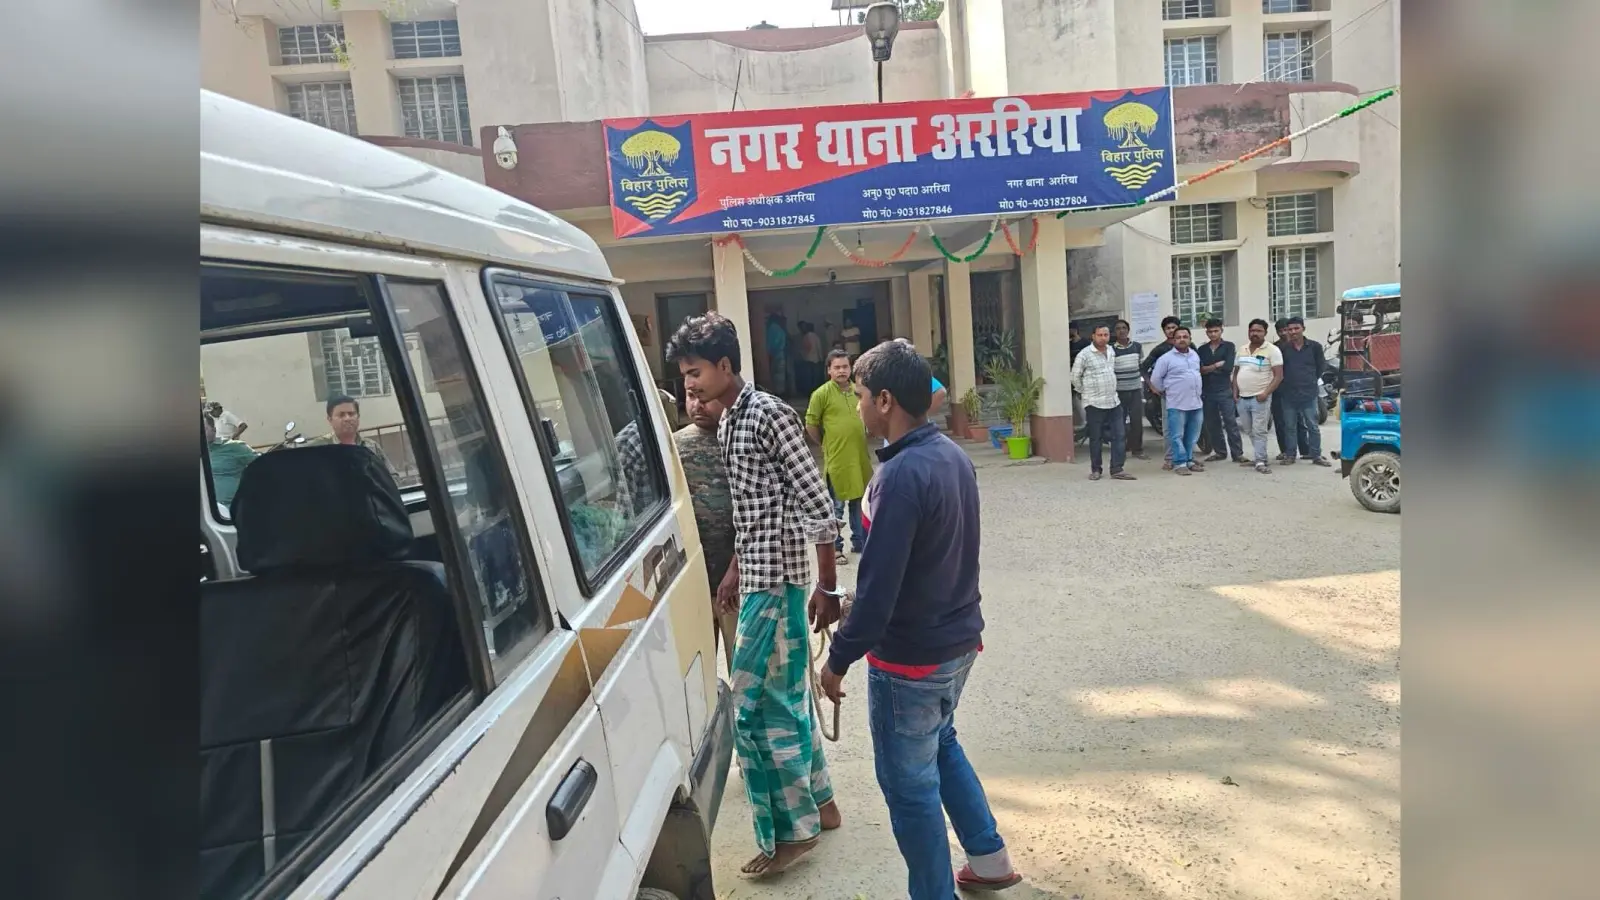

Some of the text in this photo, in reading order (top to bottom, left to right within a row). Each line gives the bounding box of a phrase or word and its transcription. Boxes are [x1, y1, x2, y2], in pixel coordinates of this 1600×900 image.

[704, 97, 1083, 173] नगर थाना अररिया
[1100, 147, 1165, 163] बिहार पुलिस
[620, 176, 689, 192] बिहार पुलिस
[921, 182, 951, 195] अररिया
[1006, 174, 1078, 189] नगर थाना अररिया
[719, 191, 815, 210] पुलिस अधीक्षक अररिया
